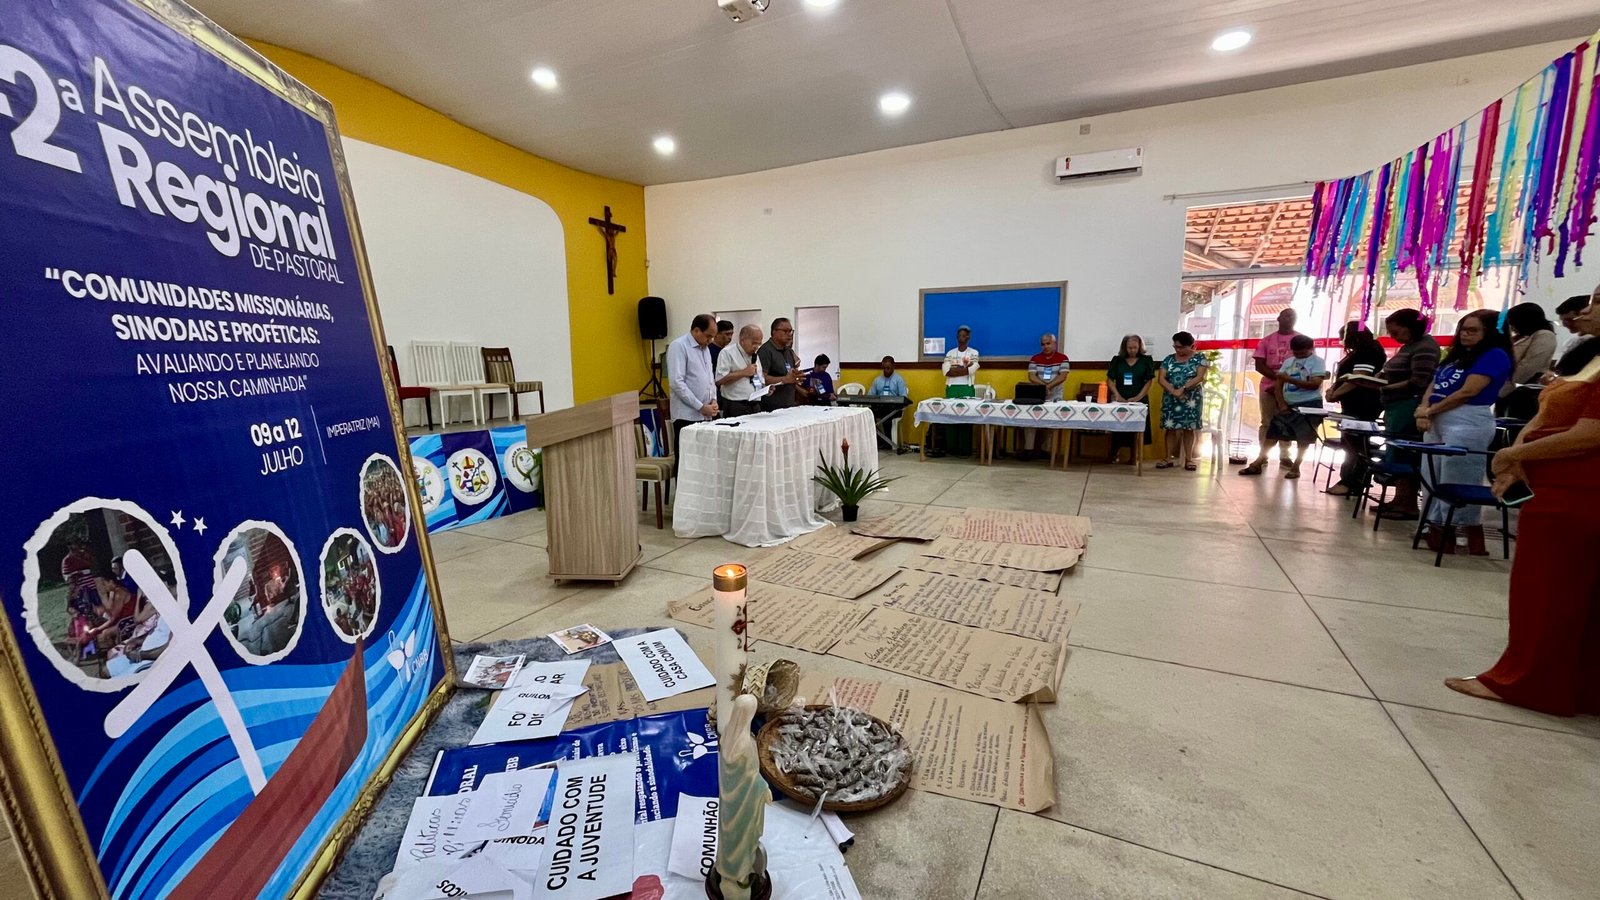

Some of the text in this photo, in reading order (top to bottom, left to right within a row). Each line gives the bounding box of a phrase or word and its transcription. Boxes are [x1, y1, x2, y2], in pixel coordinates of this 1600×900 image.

[0, 45, 325, 205] 2ª Assembleia
[97, 122, 337, 257] Regional
[249, 243, 345, 284] DE PASTORAL
[234, 292, 335, 323] MISSIONÁRIAS,
[111, 314, 321, 344] SINODAIS E PROFÉTICAS:
[136, 352, 320, 375] AVALIANDO E PLANEJANDO
[168, 381, 229, 404] NOSSA
[250, 417, 303, 447] 09 a 12
[326, 415, 381, 438] IMPERATRIZ (MA)
[260, 445, 304, 476] JULHO
[411, 648, 429, 674] CNBB
[639, 646, 656, 659] COM
[652, 640, 688, 680] CASA COMUM
[534, 675, 548, 683] O
[649, 659, 676, 688] CUIDADO
[644, 745, 656, 785] sinodalidade.
[635, 772, 648, 811] resgatando
[546, 775, 584, 891] CUIDADO COM
[577, 773, 607, 881] A JUVENTUDE
[700, 800, 719, 877] COMUNHÃO
[436, 879, 468, 897] ICOS
